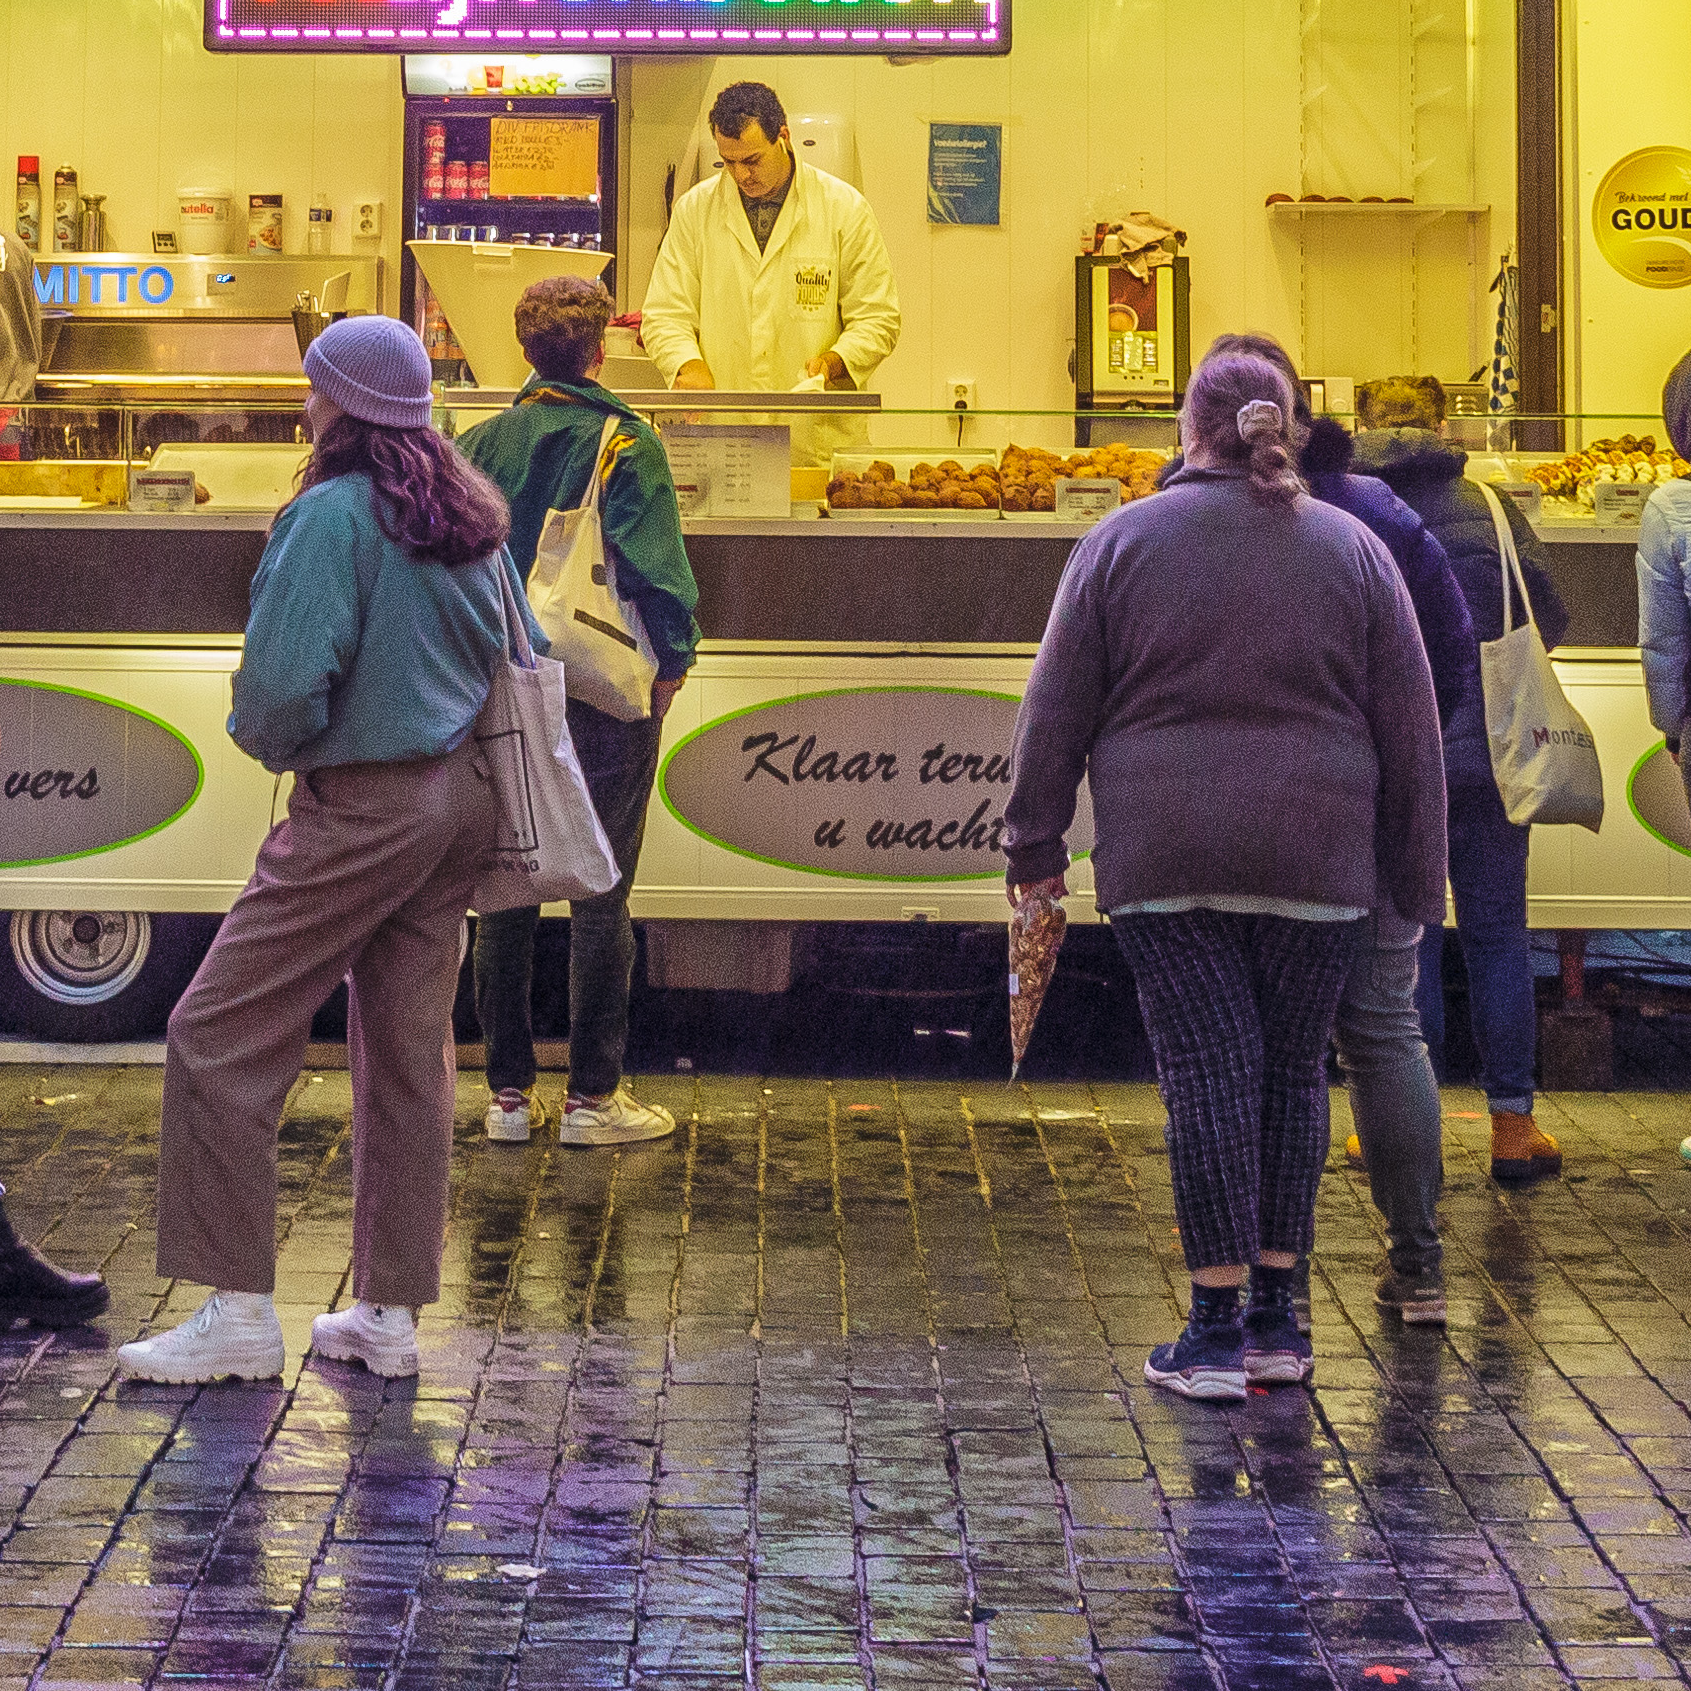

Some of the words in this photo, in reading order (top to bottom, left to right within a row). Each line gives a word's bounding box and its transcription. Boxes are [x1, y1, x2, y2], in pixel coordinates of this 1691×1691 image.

[32, 265, 174, 305] MITTO
[741, 731, 900, 786] Klaar
[4, 766, 101, 800] vers
[813, 816, 846, 849] u
